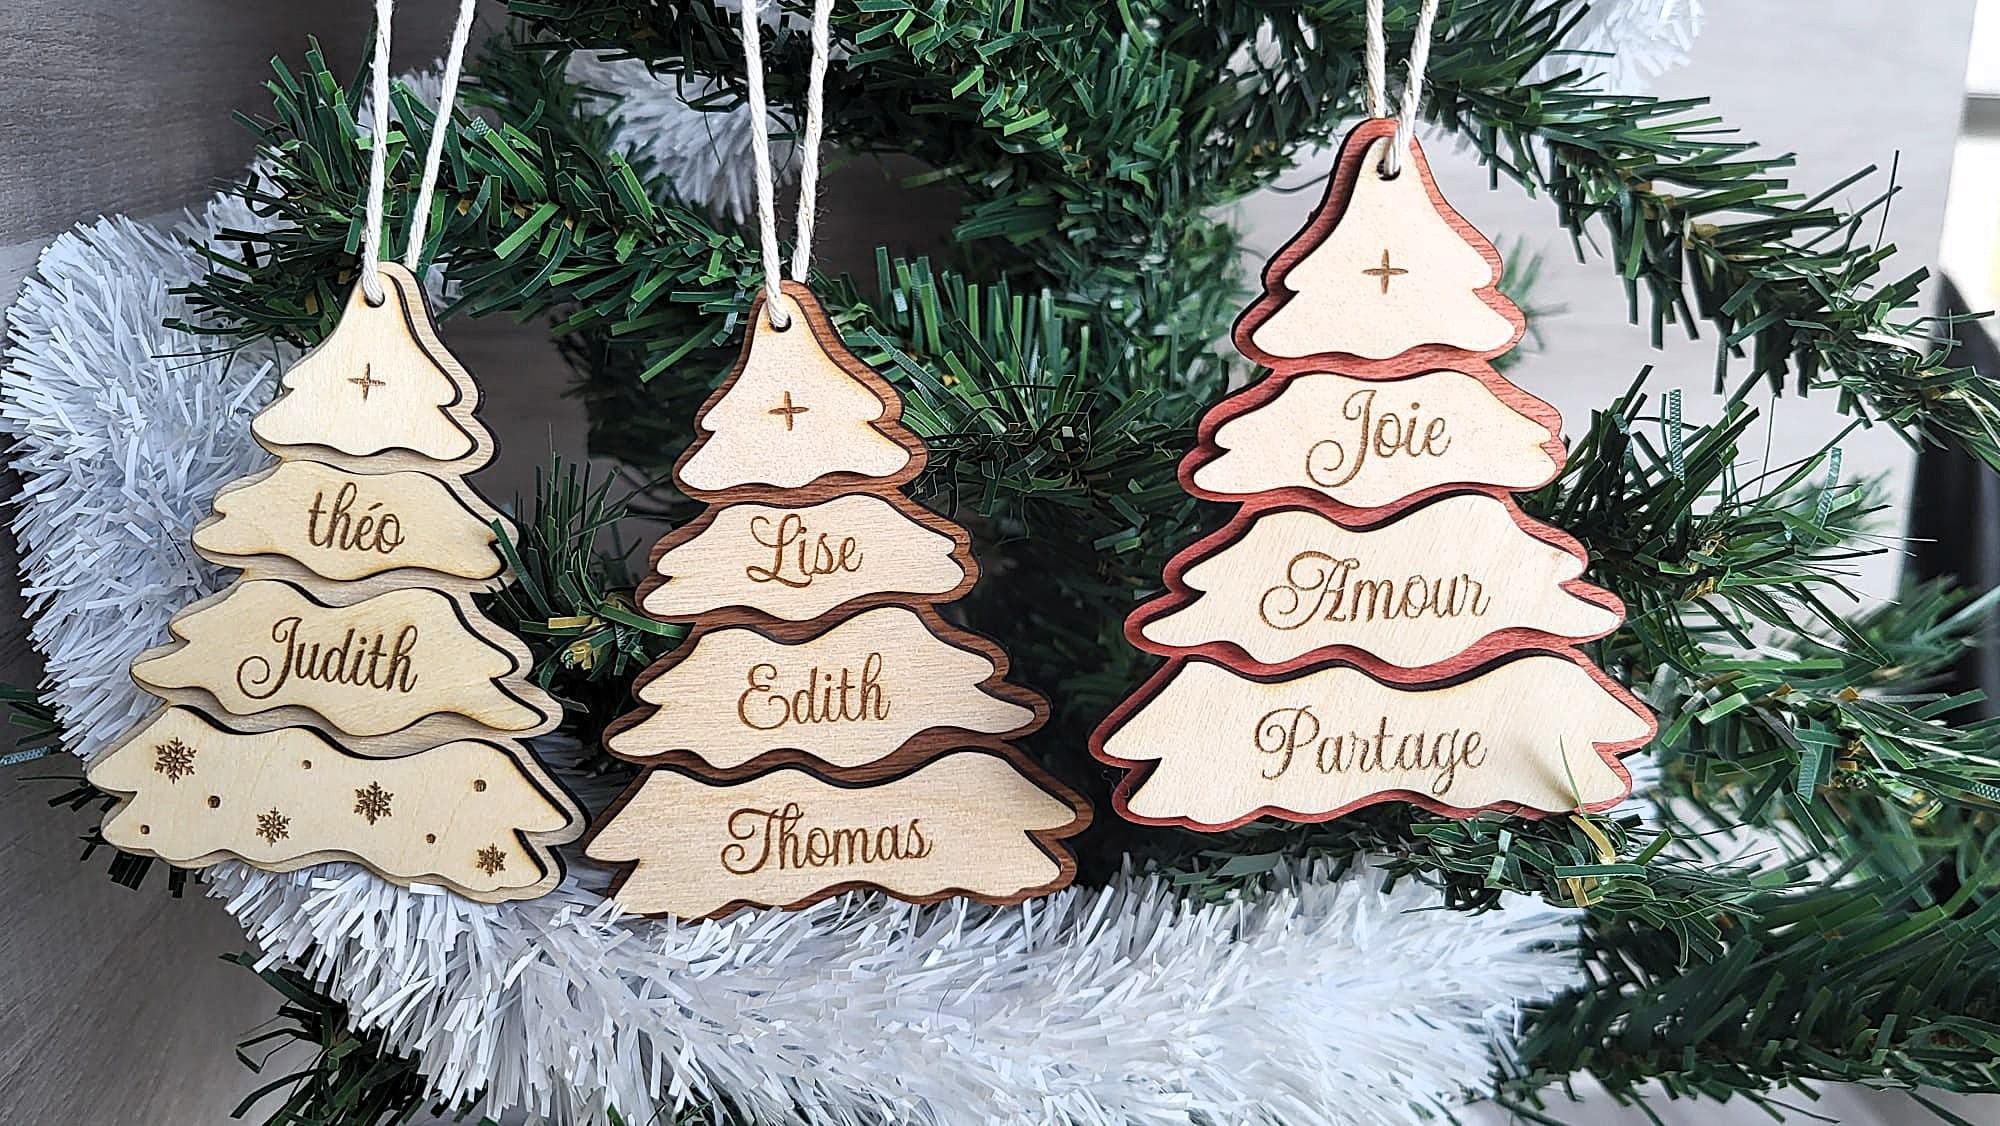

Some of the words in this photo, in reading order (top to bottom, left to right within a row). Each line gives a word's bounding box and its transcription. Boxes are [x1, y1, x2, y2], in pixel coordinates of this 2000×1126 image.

[1305, 389, 1451, 488] Joie
[308, 481, 405, 555] théo
[746, 514, 863, 588] Lise
[1259, 550, 1491, 631] Amour
[236, 616, 418, 699] Judith
[737, 652, 891, 731] Edith
[1254, 704, 1487, 796] Partage
[720, 802, 933, 875] Thomas
